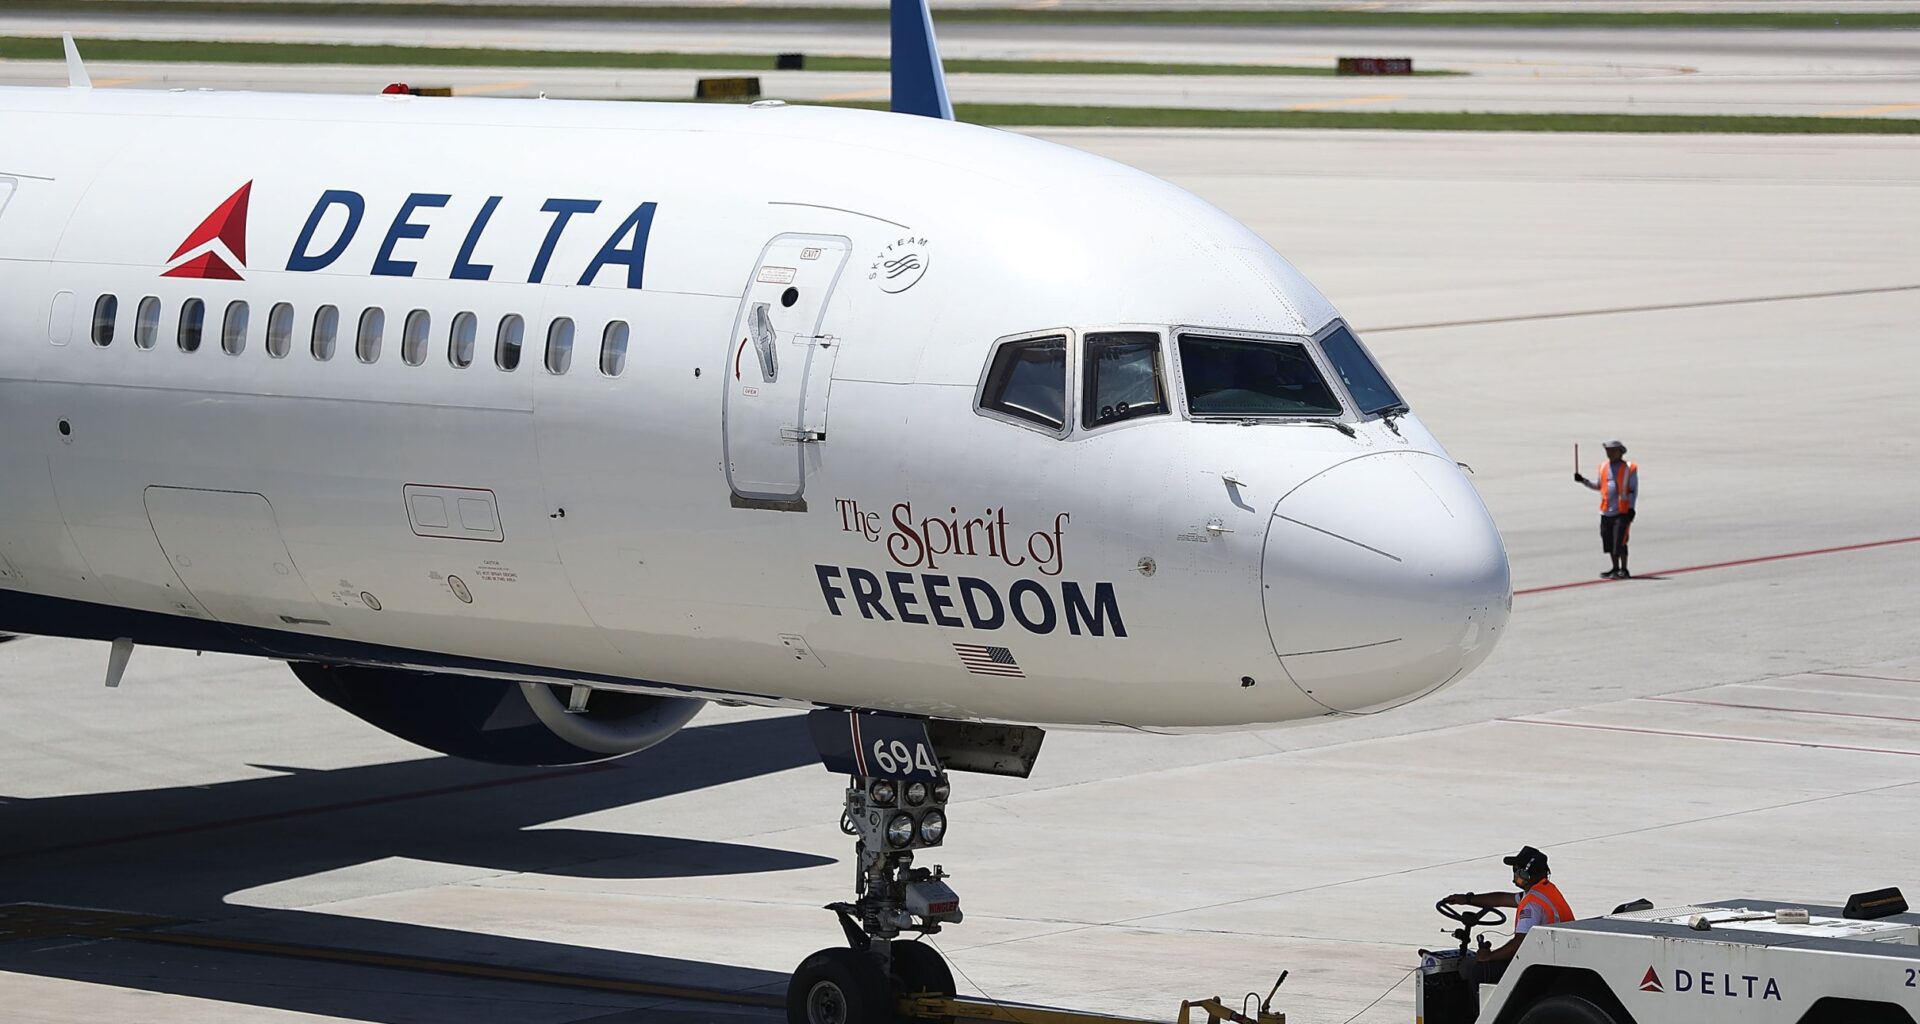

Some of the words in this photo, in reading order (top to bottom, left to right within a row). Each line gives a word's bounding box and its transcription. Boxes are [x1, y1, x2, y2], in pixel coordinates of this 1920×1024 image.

[285, 189, 658, 290] DELTA
[868, 236, 928, 280] SKYTEAM
[835, 497, 882, 542] The
[886, 501, 1026, 569] Spirit
[1027, 512, 1071, 576] of
[814, 564, 1128, 638] FREEDOM
[873, 739, 937, 777] 694
[1675, 969, 1782, 1001] DELTA
[1904, 968, 1920, 987] 2
